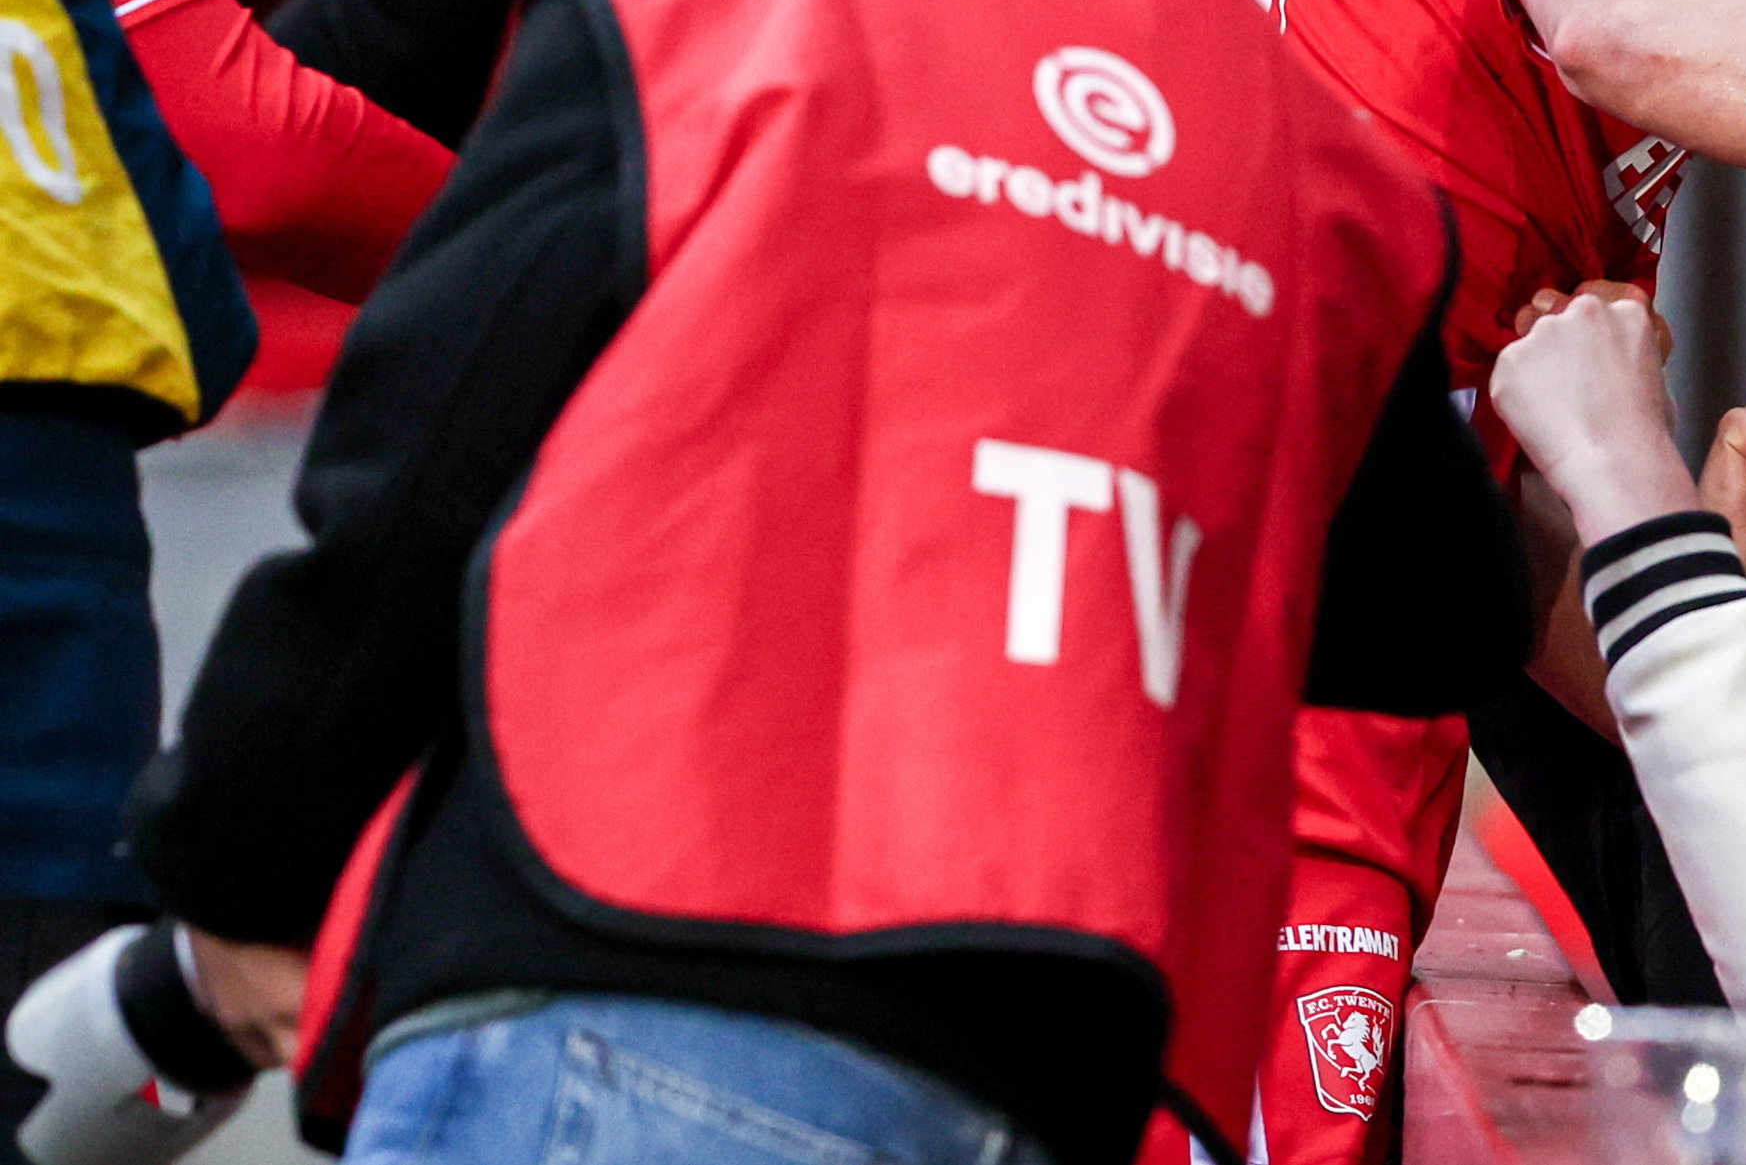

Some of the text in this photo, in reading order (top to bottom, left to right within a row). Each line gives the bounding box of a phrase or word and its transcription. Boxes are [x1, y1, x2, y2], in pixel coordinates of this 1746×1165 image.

[926, 142, 1276, 318] eredivisie
[971, 437, 1205, 711] TV
[1277, 923, 1400, 962] ELEKTRAMAT
[1306, 994, 1391, 1019] F.C. TWENTE
